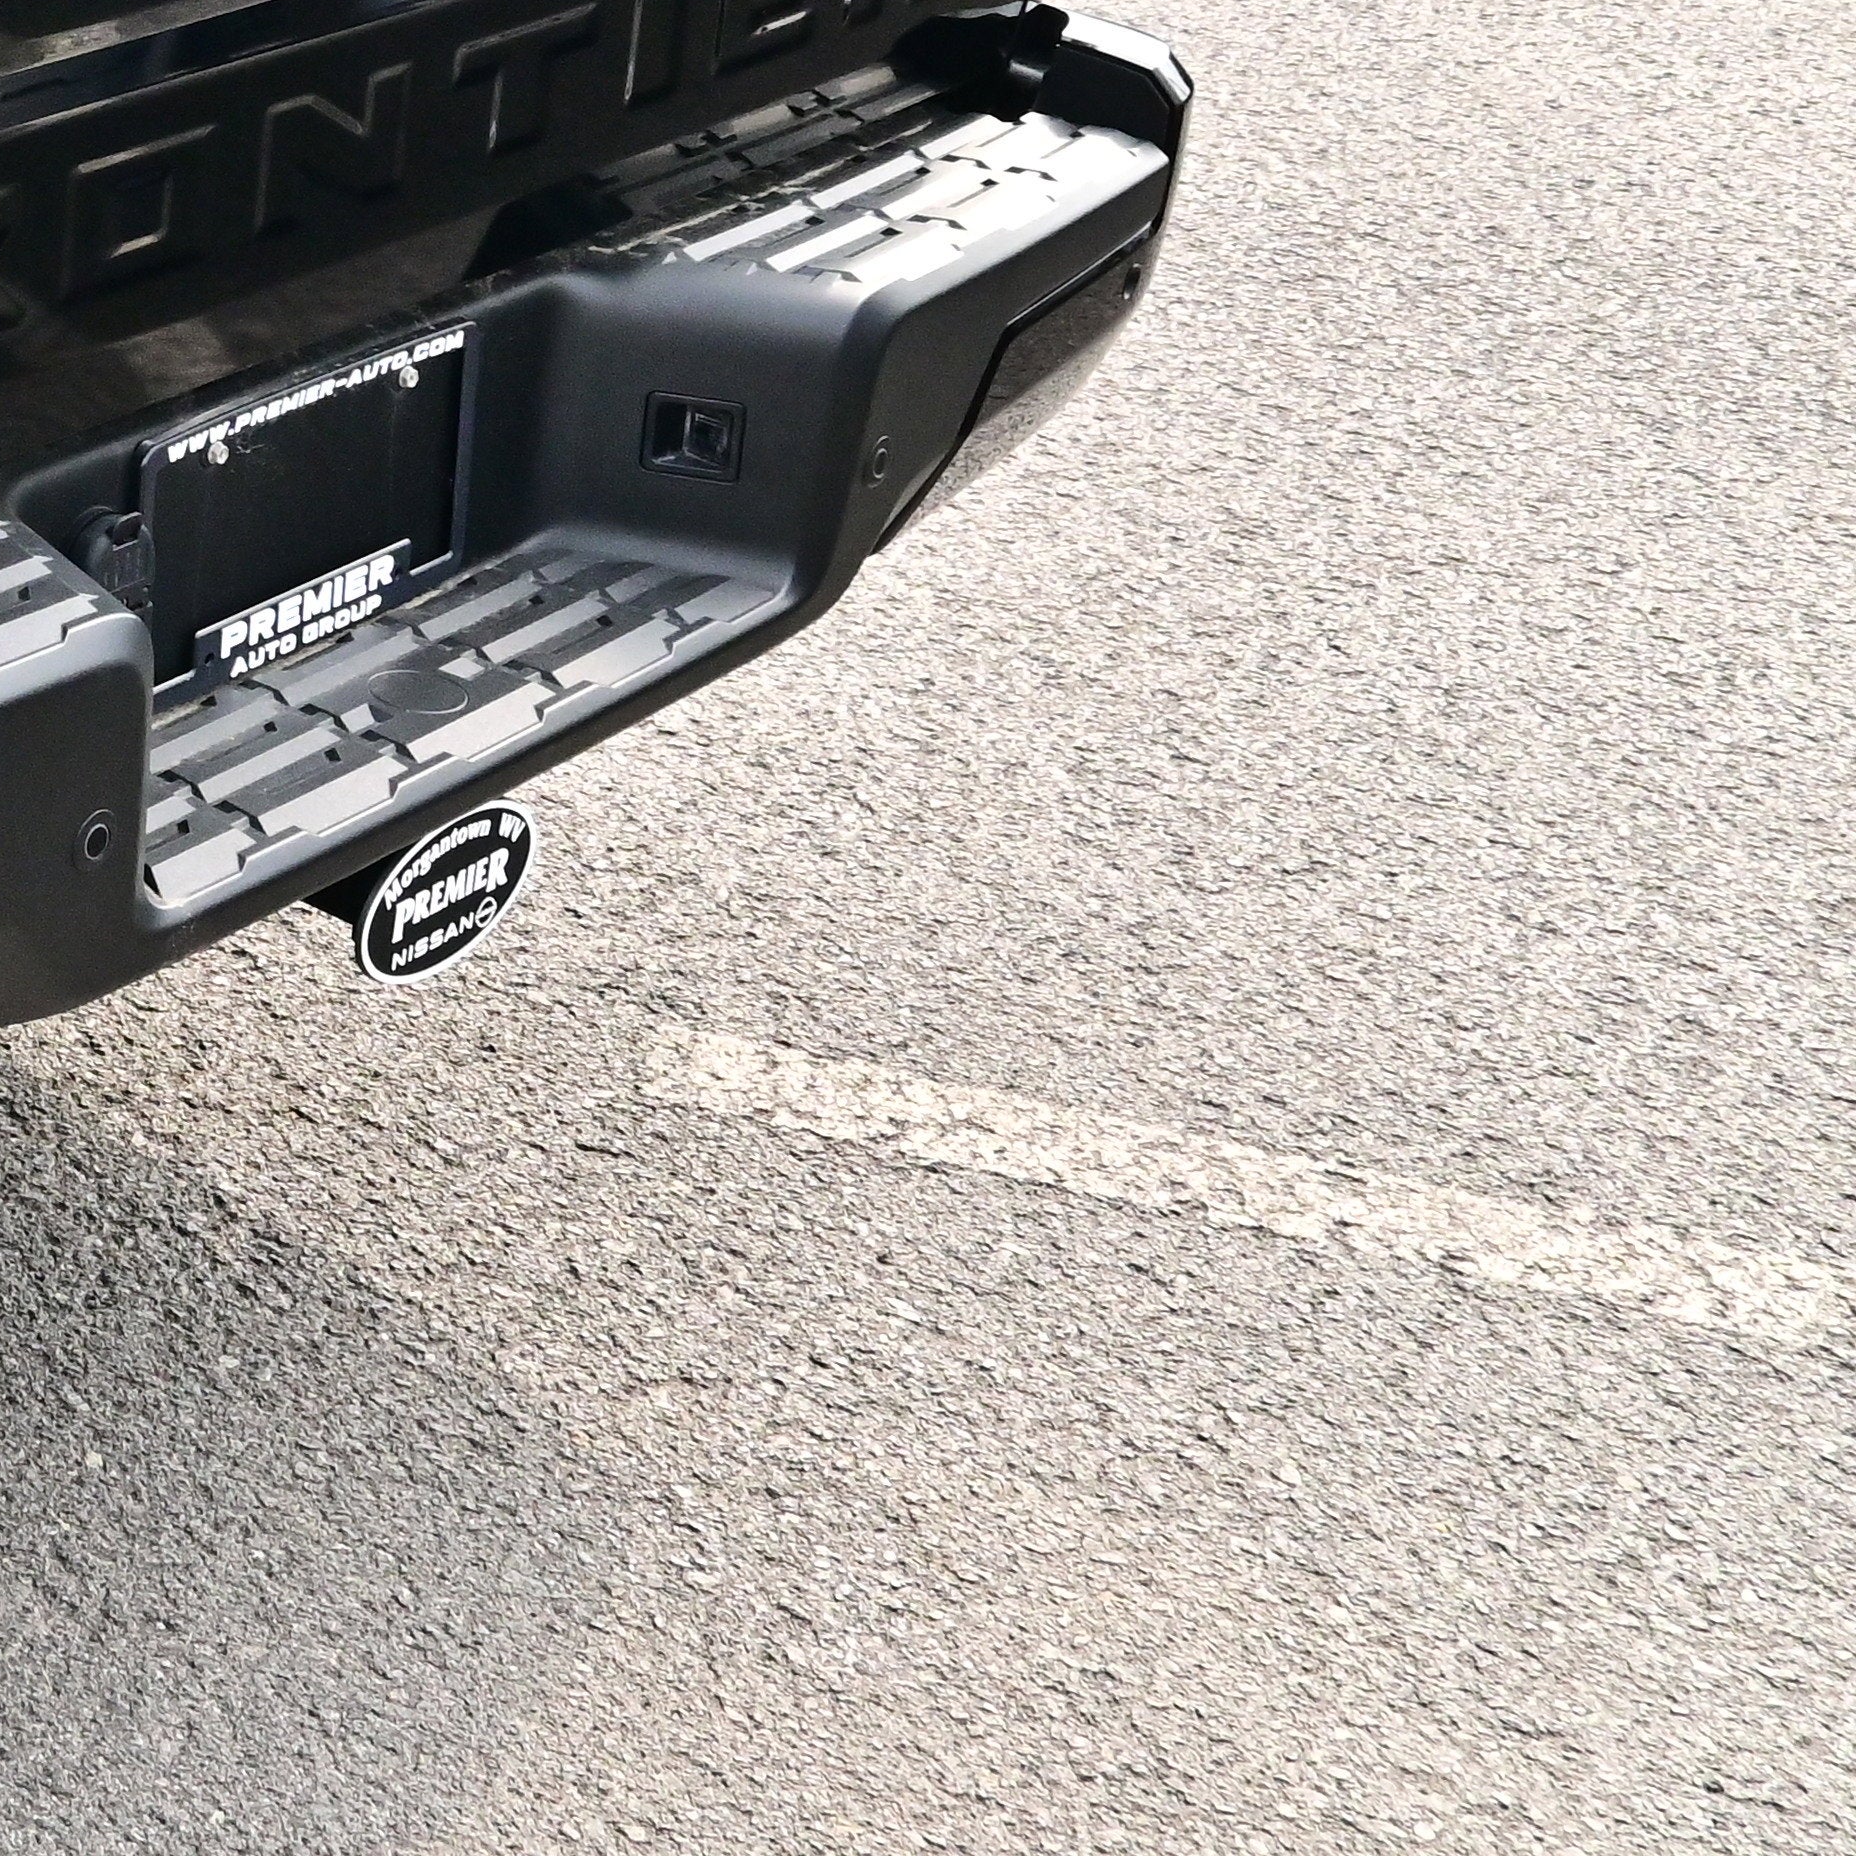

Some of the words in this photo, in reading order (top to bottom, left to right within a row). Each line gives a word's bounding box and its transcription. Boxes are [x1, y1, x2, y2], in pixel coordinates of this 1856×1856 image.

[167, 330, 465, 463] WWW.PREMIER-AUTO.COM
[220, 553, 395, 660] PREMIER
[229, 633, 297, 678] AUTO
[302, 593, 383, 645] GROUP
[384, 818, 492, 910] Morgantown
[498, 812, 527, 843] WV
[391, 847, 510, 944] PREMIER
[390, 912, 475, 971] NISSAN
